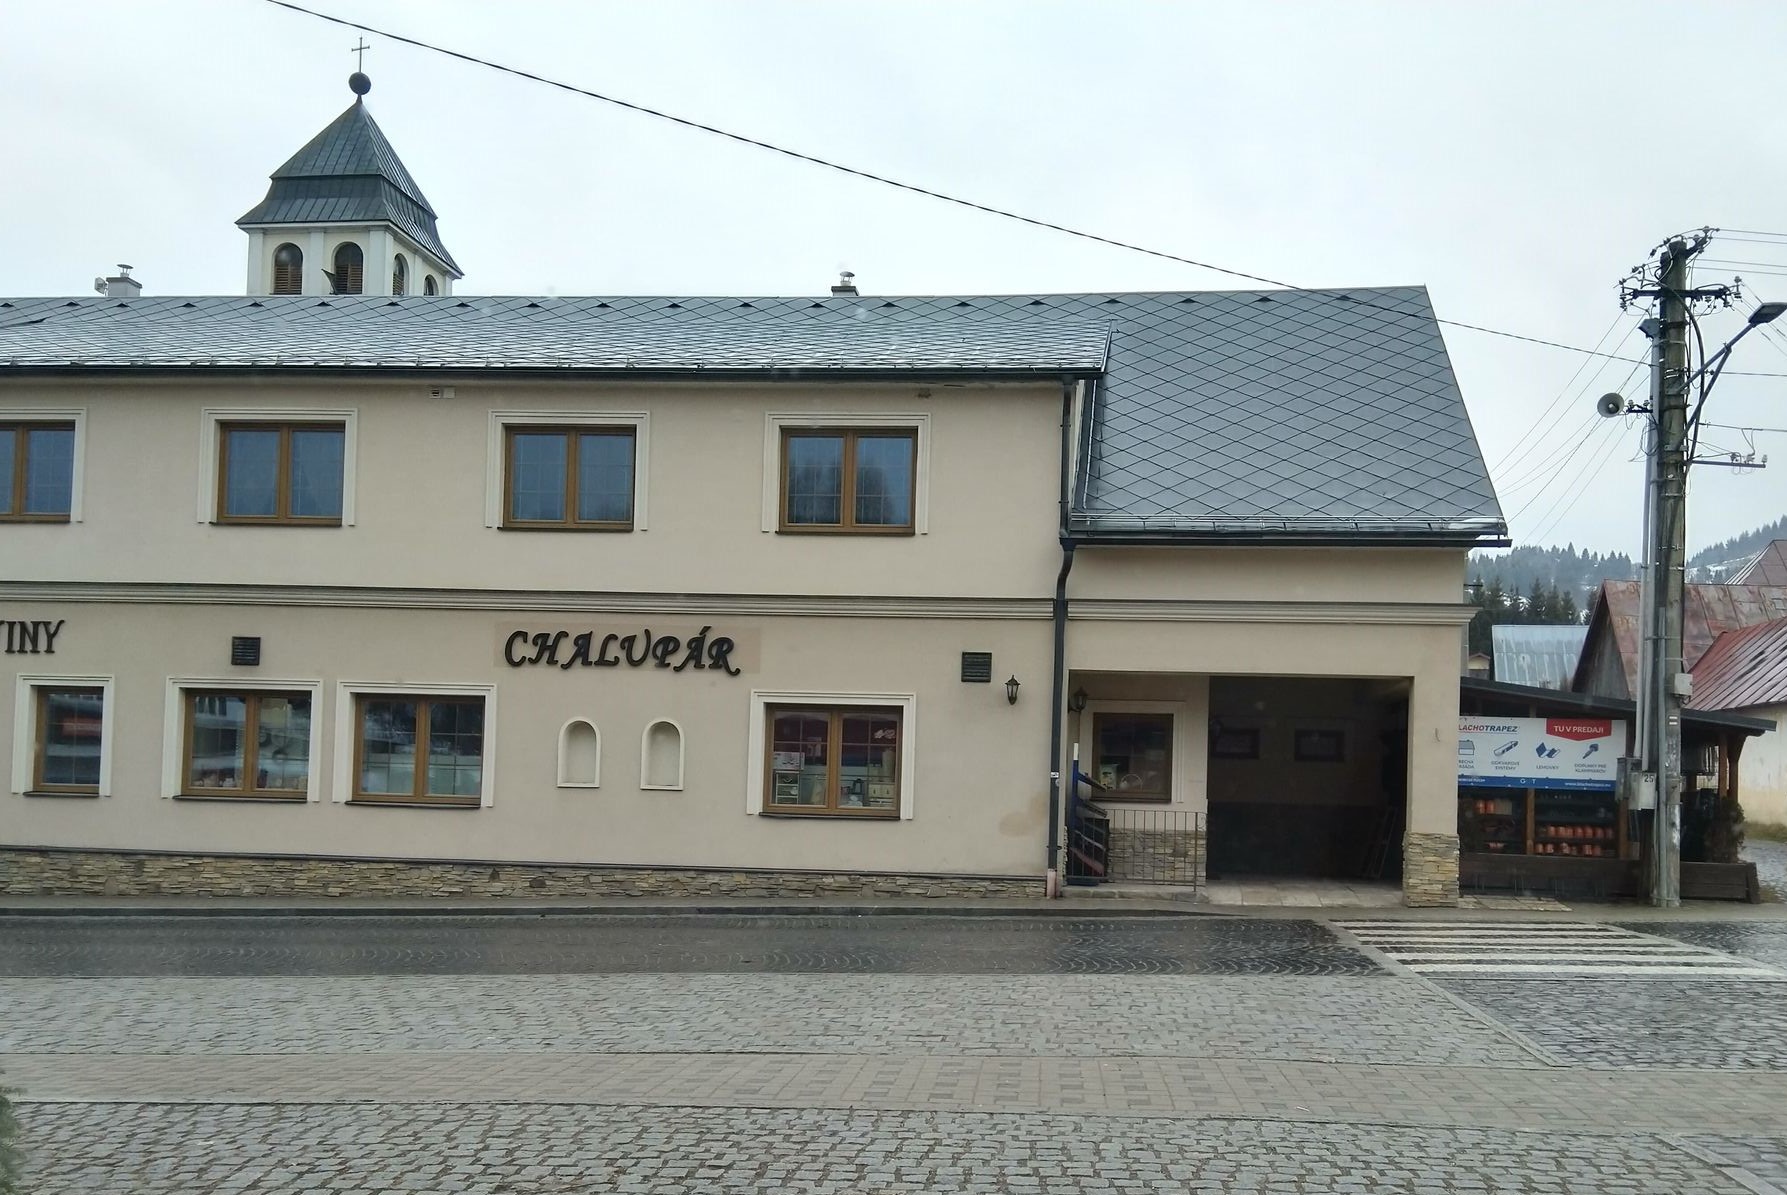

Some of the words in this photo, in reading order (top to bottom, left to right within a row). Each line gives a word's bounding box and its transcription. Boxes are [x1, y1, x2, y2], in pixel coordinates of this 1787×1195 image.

[0, 619, 66, 654] INY
[504, 625, 742, 676] CHALUPÁR
[1554, 725, 1564, 733] TU
[1565, 725, 1572, 733] V
[1644, 774, 1654, 783] 25
